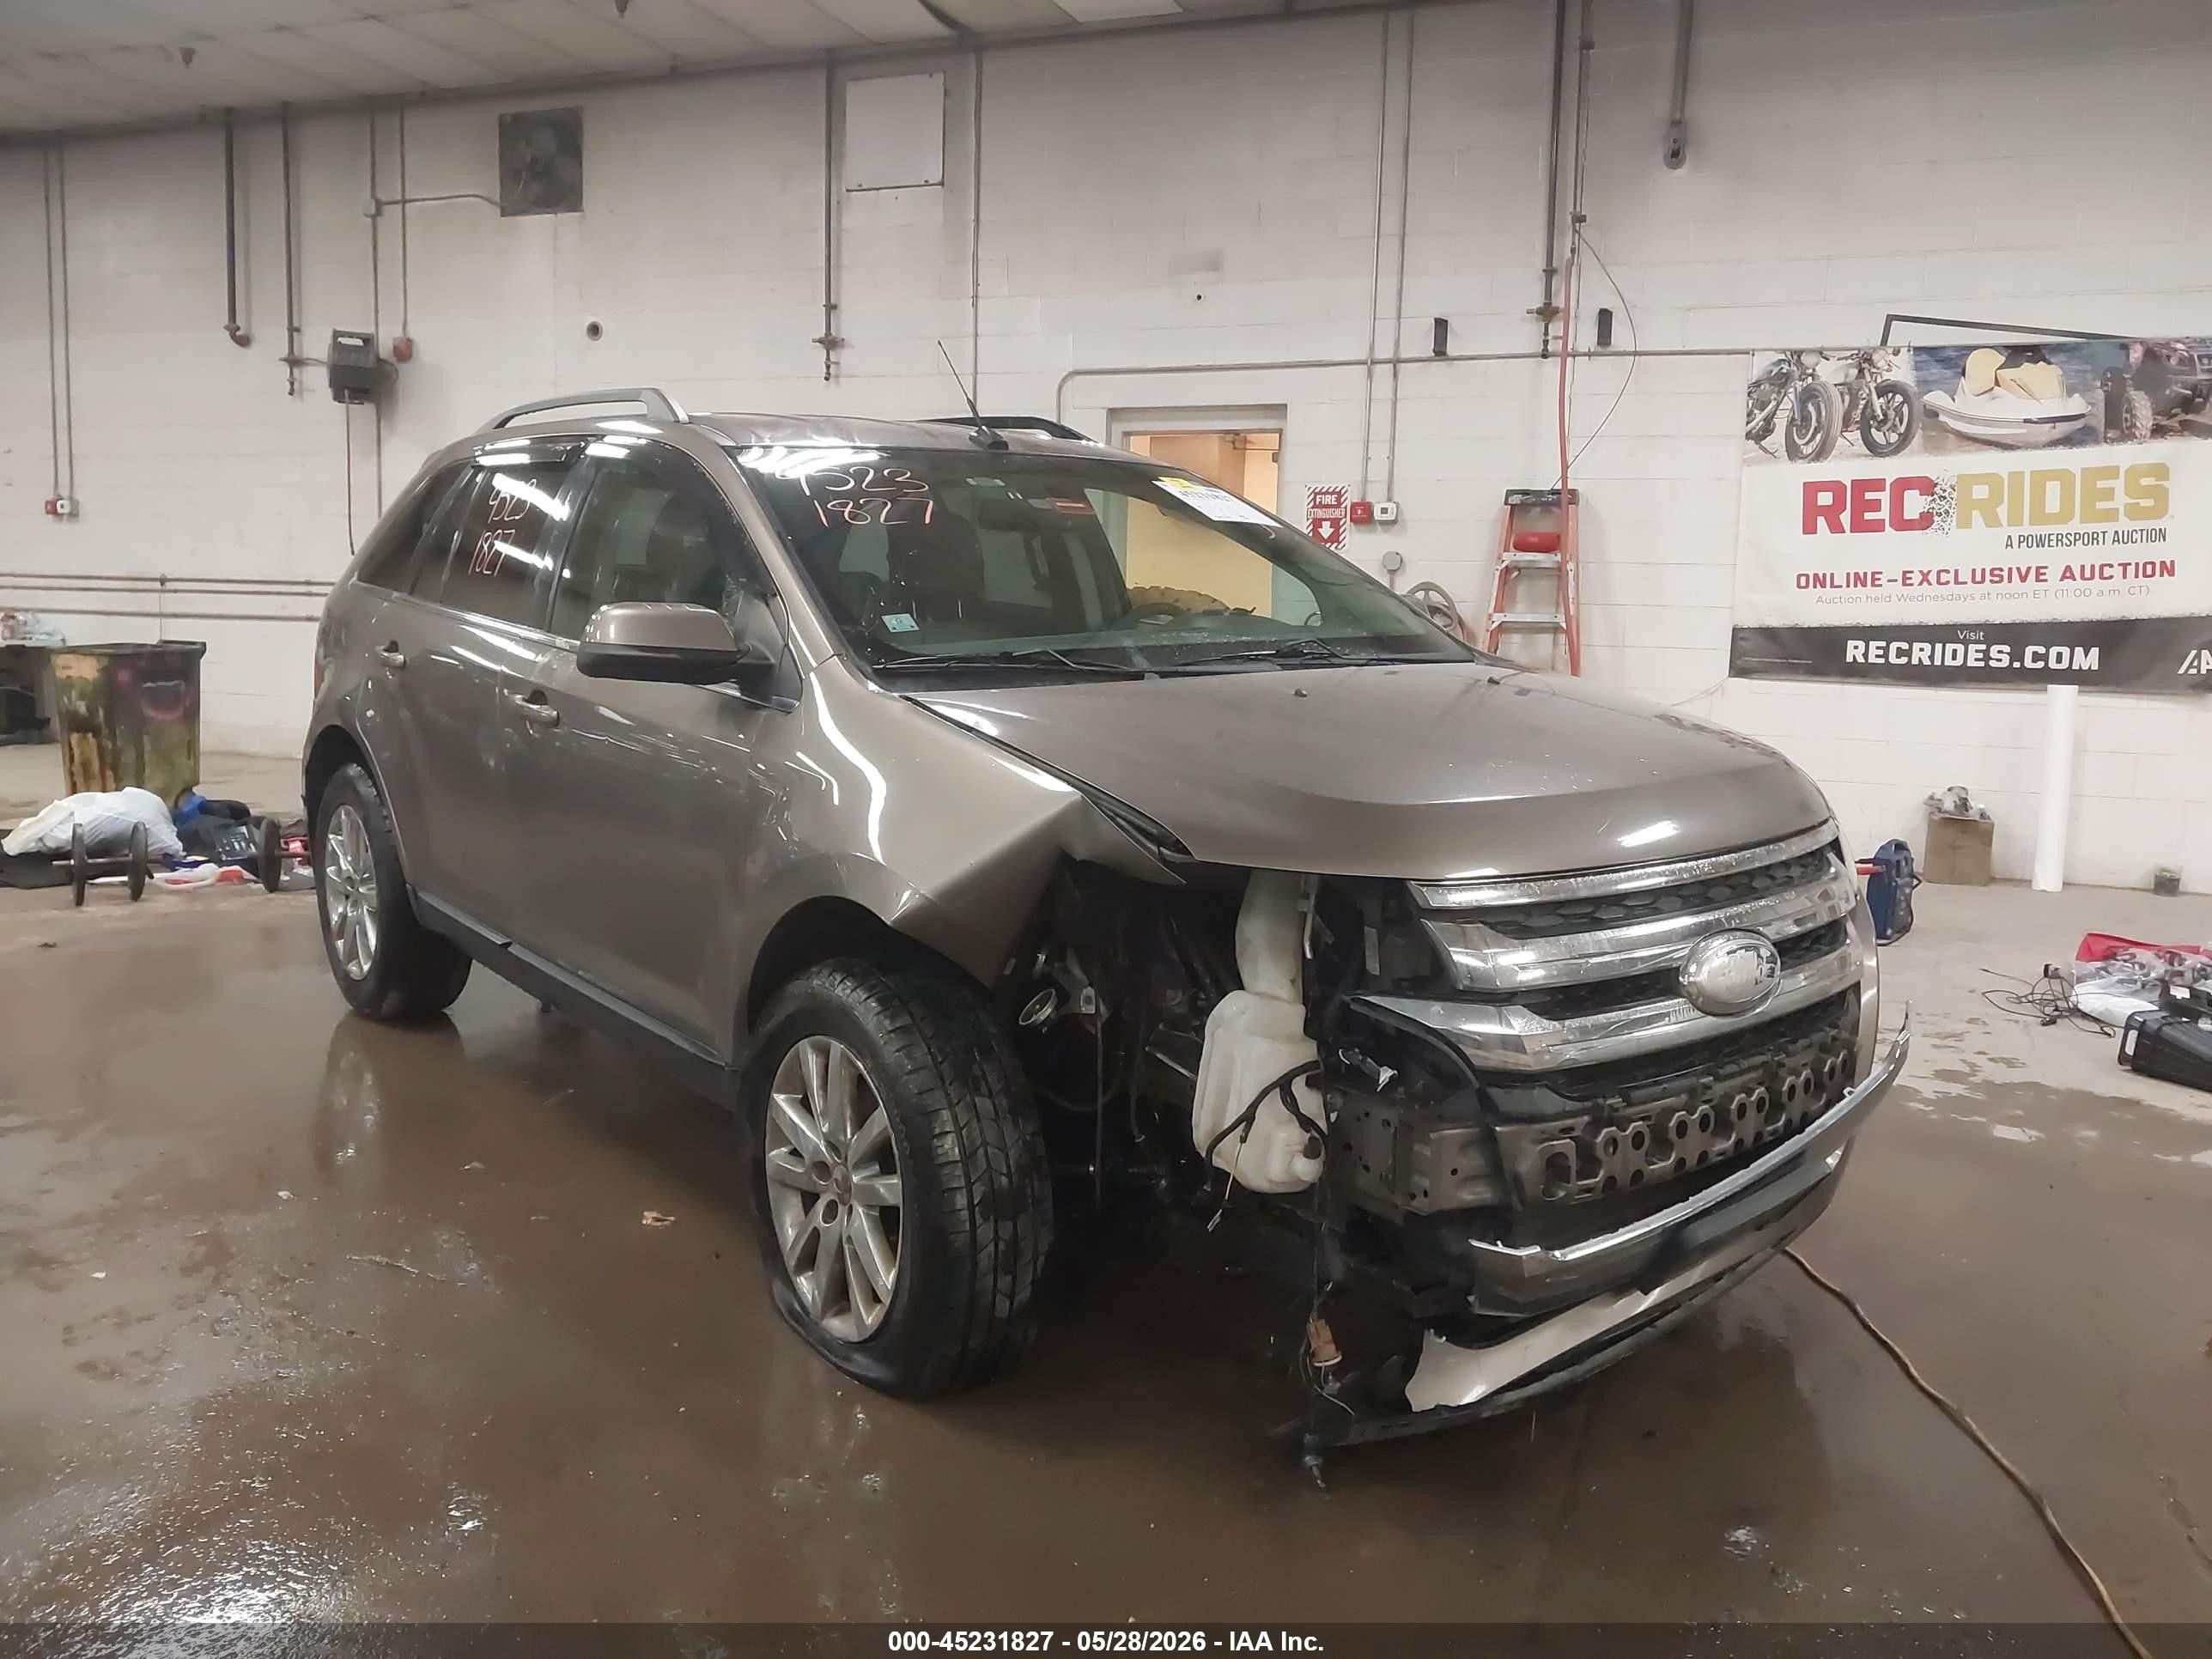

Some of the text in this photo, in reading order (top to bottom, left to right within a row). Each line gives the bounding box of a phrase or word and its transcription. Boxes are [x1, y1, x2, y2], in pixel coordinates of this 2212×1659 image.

[1315, 494, 1339, 505] FIRE
[1802, 462, 2171, 535] REC RIDES
[813, 497, 935, 528] 1827
[1307, 507, 1346, 519] EXTINGUISHER
[2004, 527, 2168, 550] A POWERSPORT AUCTION
[467, 529, 516, 578] 1827
[1796, 559, 2177, 590] ONLINE-EXCLUSIVE AUCTION
[1815, 594, 1862, 605] Auction
[1865, 592, 1893, 604] held
[1896, 590, 1976, 604] Wednesdays
[1978, 591, 1992, 601] at
[1996, 589, 2029, 601] noon
[2033, 589, 2051, 599] ET
[2054, 587, 2093, 600] (11:00
[2127, 584, 2151, 598] CT)
[1957, 629, 1985, 641] Visit
[1845, 640, 2100, 671] RECRIDES.COM
